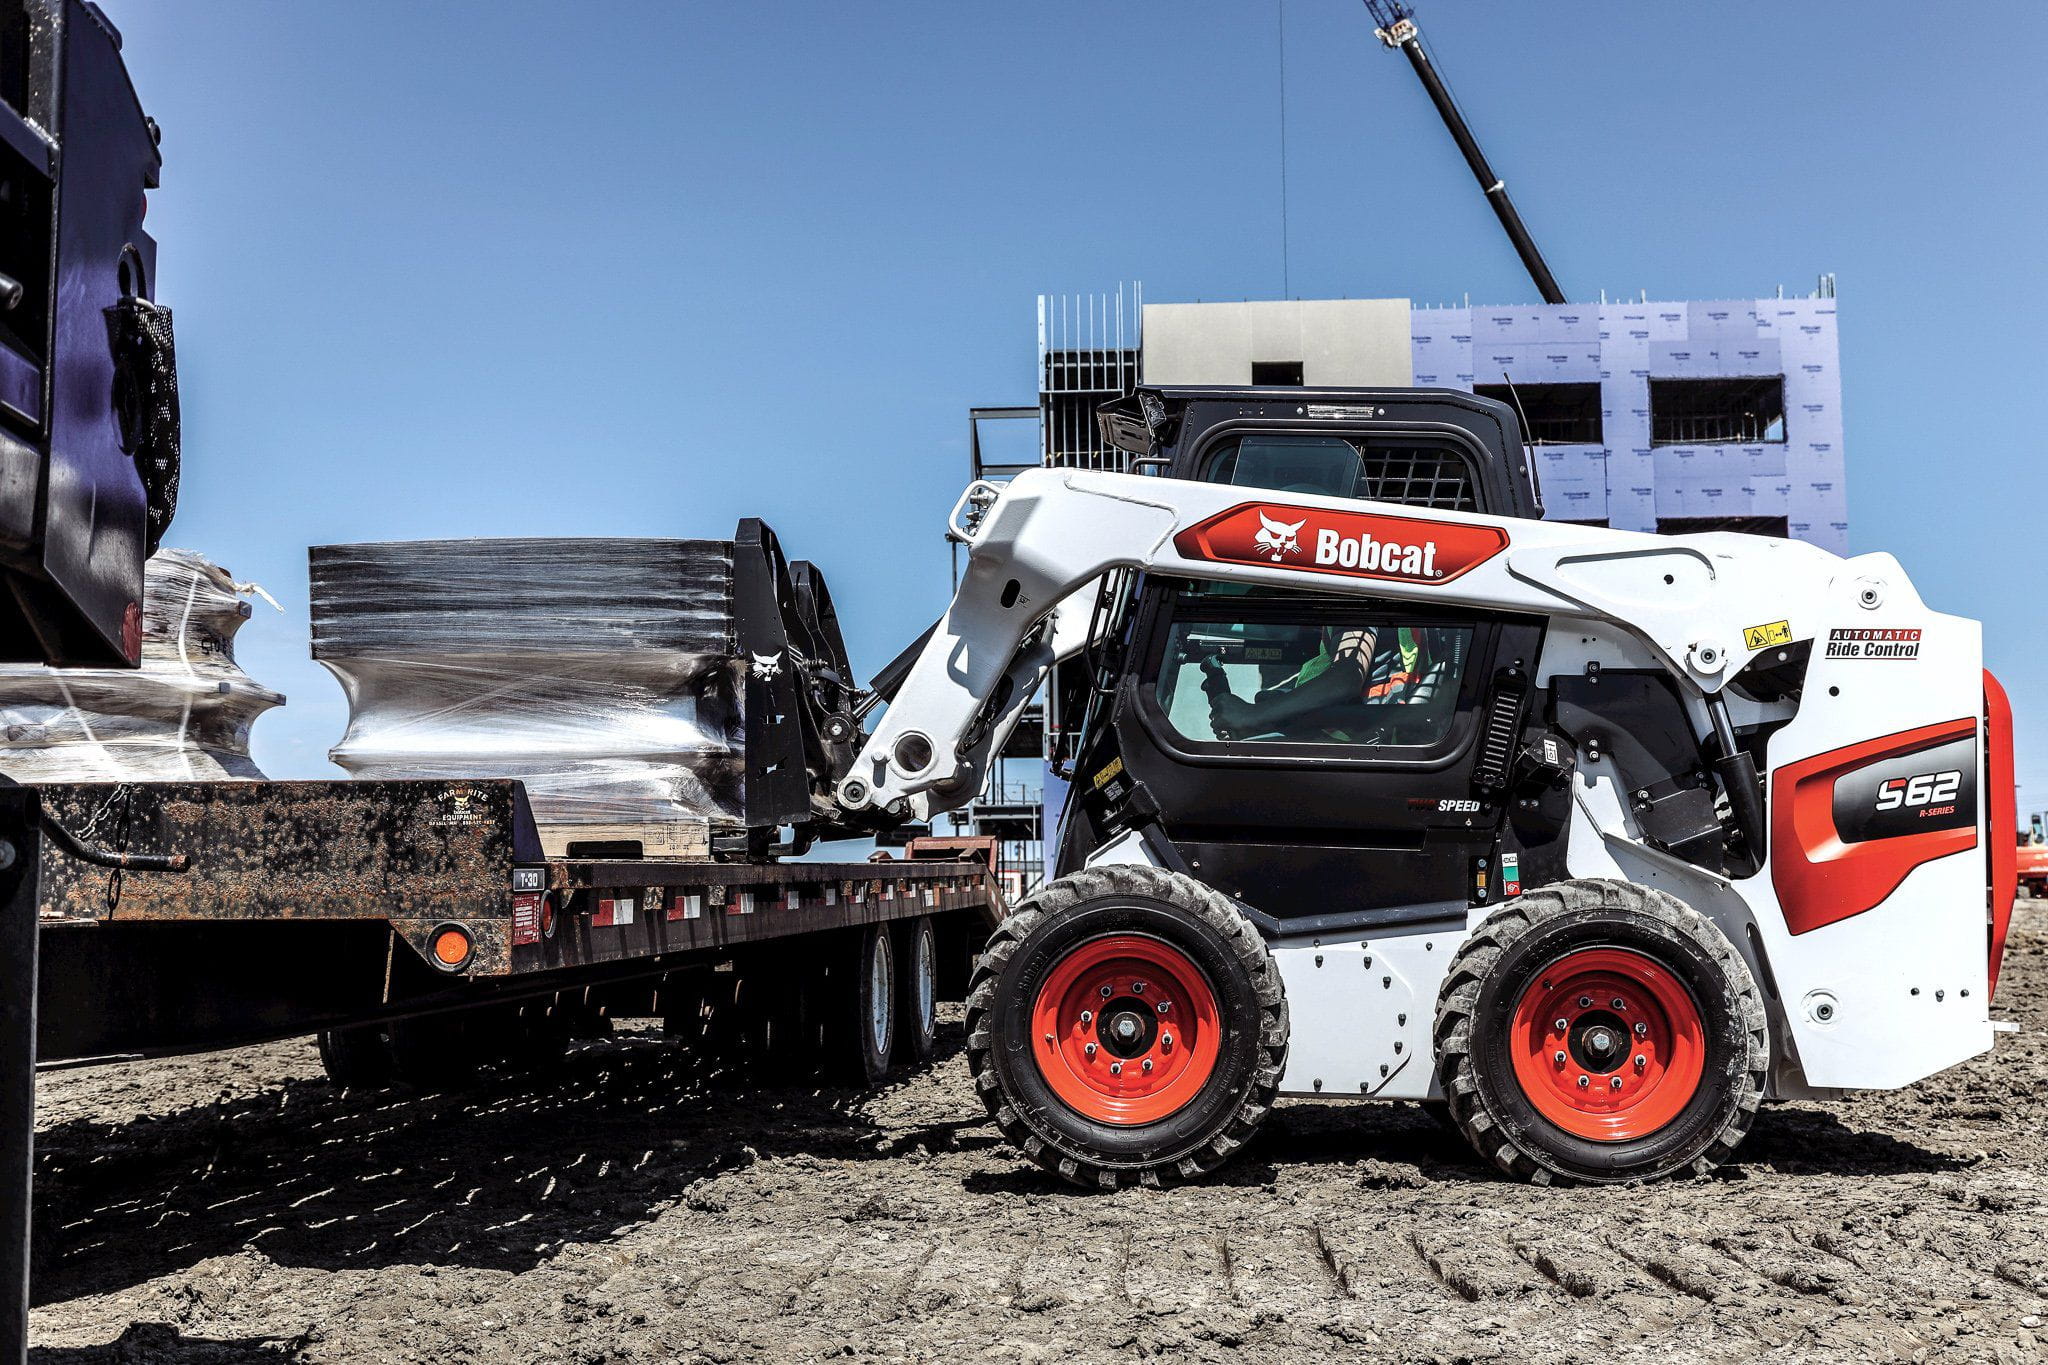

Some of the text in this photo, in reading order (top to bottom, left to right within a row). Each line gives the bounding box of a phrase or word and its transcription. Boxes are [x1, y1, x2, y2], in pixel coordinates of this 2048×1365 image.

[1315, 528, 1437, 577] Bobcat
[1831, 630, 1920, 640] AUTOMATIC
[1826, 641, 1920, 657] Ride Control
[467, 788, 489, 802] RITE
[1875, 769, 1964, 811] S62
[1438, 799, 1481, 812] SPEED
[1919, 804, 1956, 818] R-SERIES
